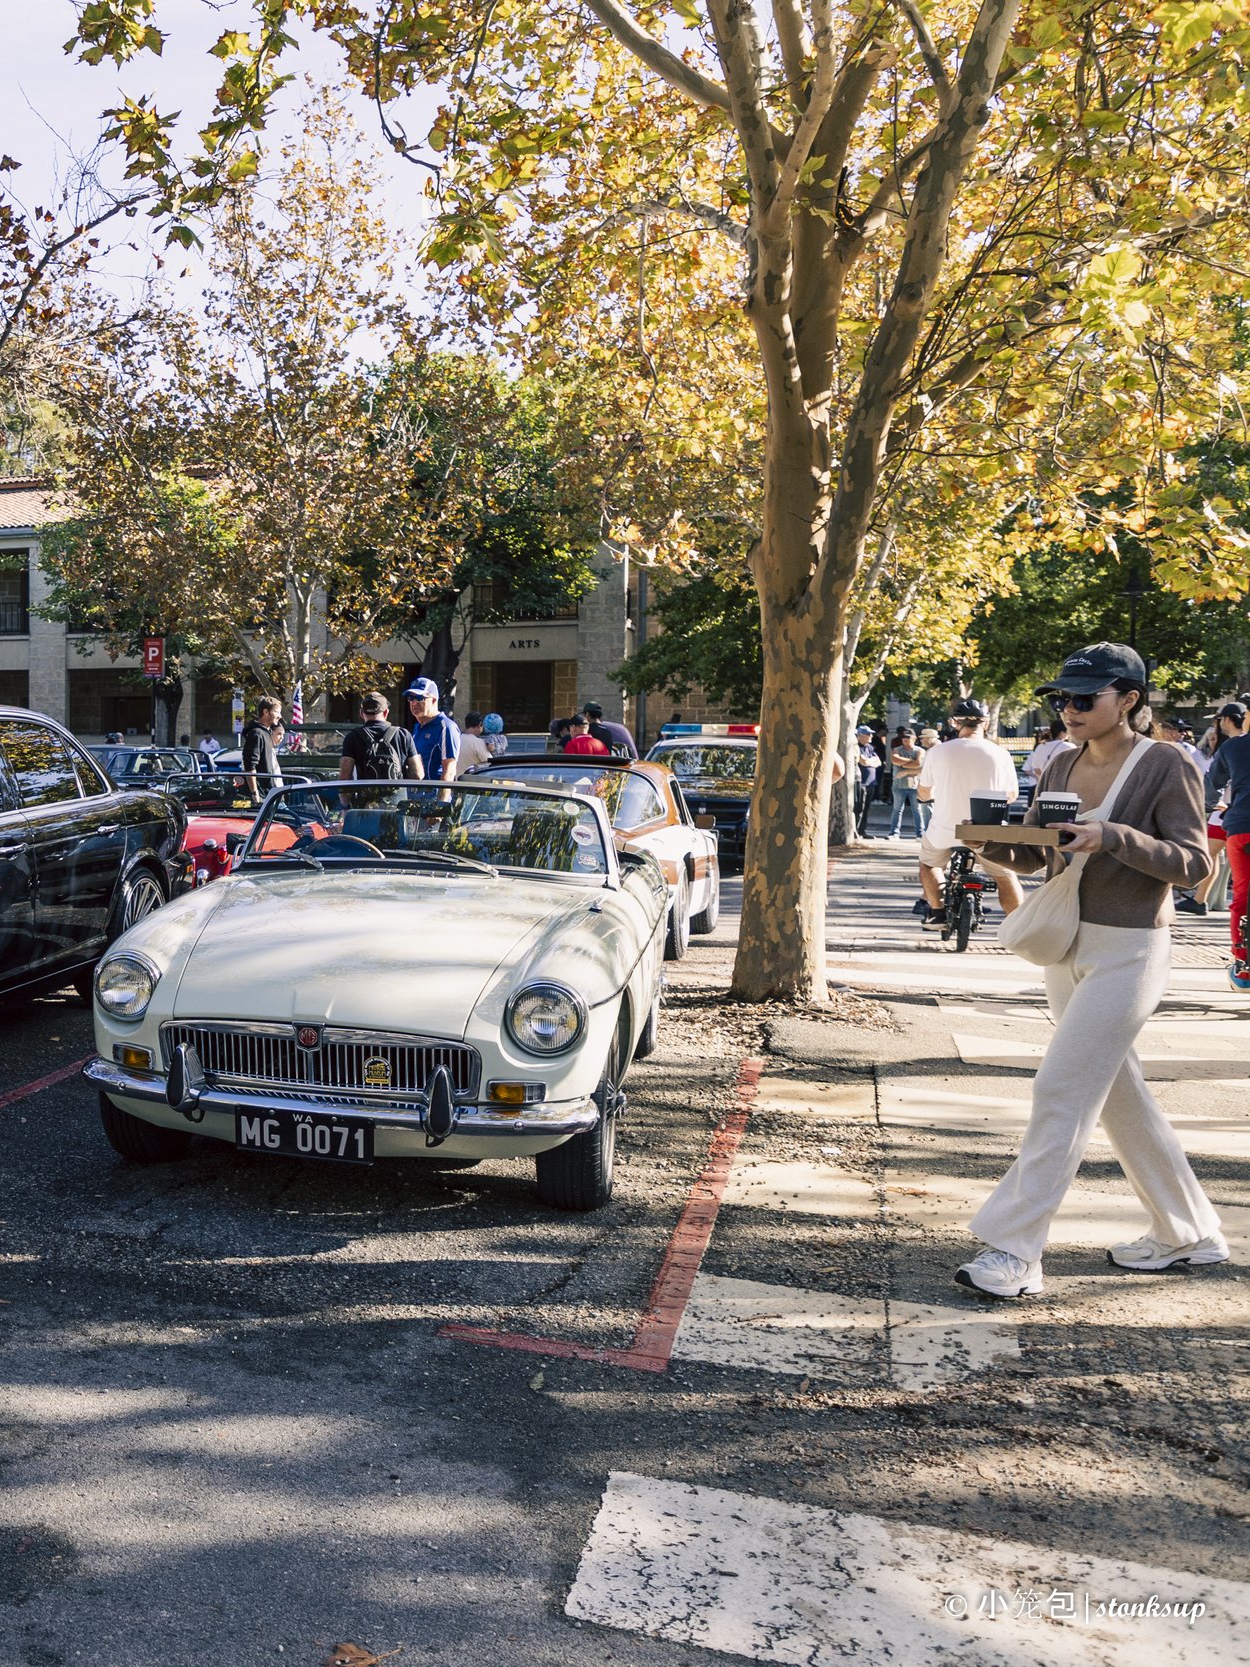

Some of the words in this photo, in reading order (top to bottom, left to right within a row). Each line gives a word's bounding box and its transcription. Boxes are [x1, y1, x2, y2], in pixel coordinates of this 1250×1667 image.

[509, 640, 540, 648] ARTS
[149, 647, 159, 661] P
[293, 1114, 313, 1123] WA
[241, 1116, 281, 1148] MG
[296, 1123, 364, 1158] 0071
